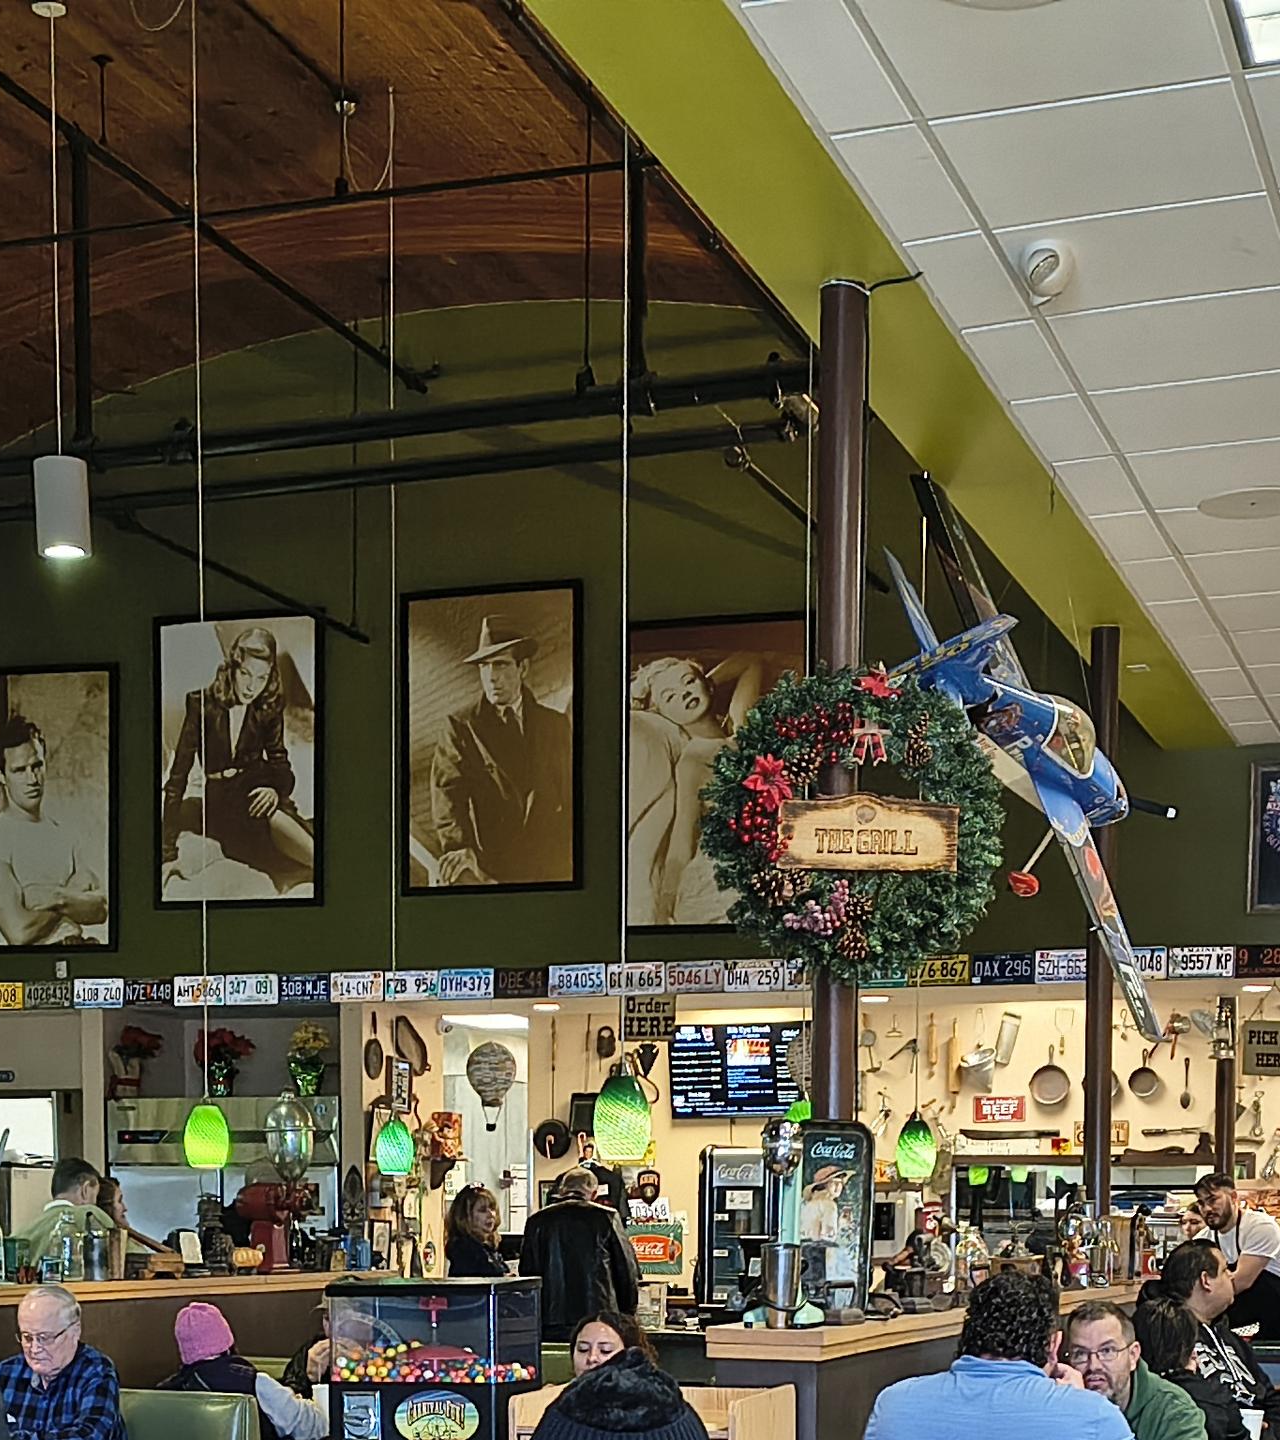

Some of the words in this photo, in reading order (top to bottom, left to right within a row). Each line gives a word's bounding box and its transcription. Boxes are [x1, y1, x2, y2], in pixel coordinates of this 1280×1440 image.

[815, 828, 854, 854] THE
[856, 829, 918, 855] GRILL
[1180, 953, 1213, 971] 9557
[1216, 953, 1232, 970] KP
[1238, 949, 1249, 966] 9
[704, 968, 721, 985] LY
[1005, 960, 1031, 976] 296
[414, 977, 436, 993] 956
[468, 975, 491, 992] 379
[638, 969, 663, 987] 665
[757, 968, 780, 986] 259
[81, 987, 99, 1002] 108
[150, 984, 172, 1000] 448
[228, 981, 247, 995] 347
[626, 996, 670, 1014] Order
[624, 1016, 675, 1036] HERE
[1248, 1031, 1279, 1046] PICK
[982, 1103, 1018, 1115] BEEF
[810, 1141, 856, 1161] Coca-Cola
